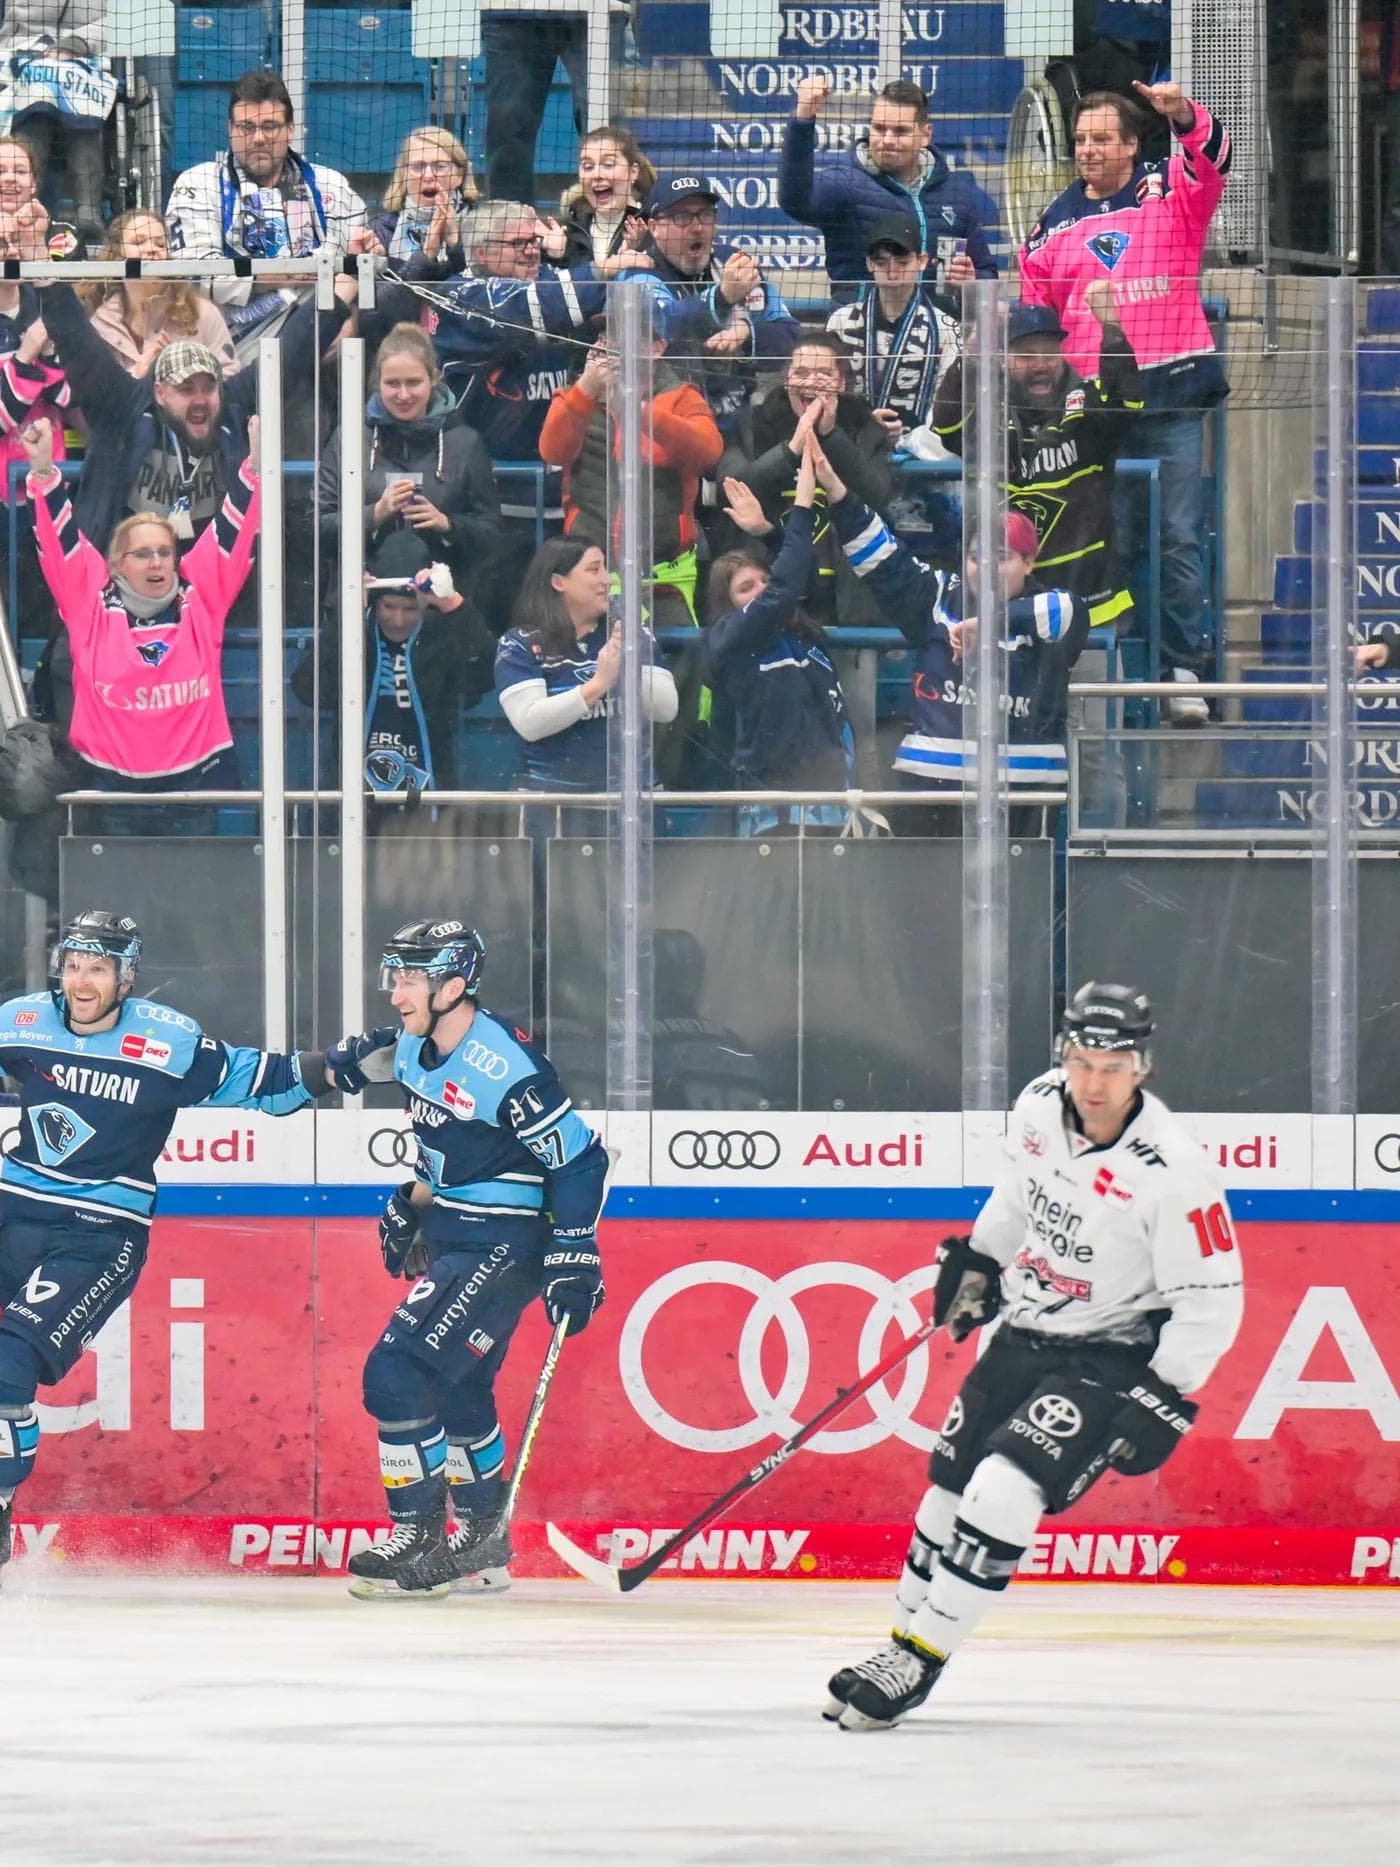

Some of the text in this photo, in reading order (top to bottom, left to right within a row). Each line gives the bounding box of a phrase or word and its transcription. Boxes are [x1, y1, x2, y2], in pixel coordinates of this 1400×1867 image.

[1111, 275, 1171, 308] TURN
[15, 1011, 37, 1026] DB
[18, 1029, 53, 1044] Bayern
[50, 1063, 141, 1106] SATURN
[802, 1133, 924, 1168] Audi
[1124, 1136, 1169, 1169] HIT
[1186, 1200, 1234, 1259] 10
[1006, 1417, 1064, 1462] TOYOTA
[749, 1439, 797, 1483] SYNC
